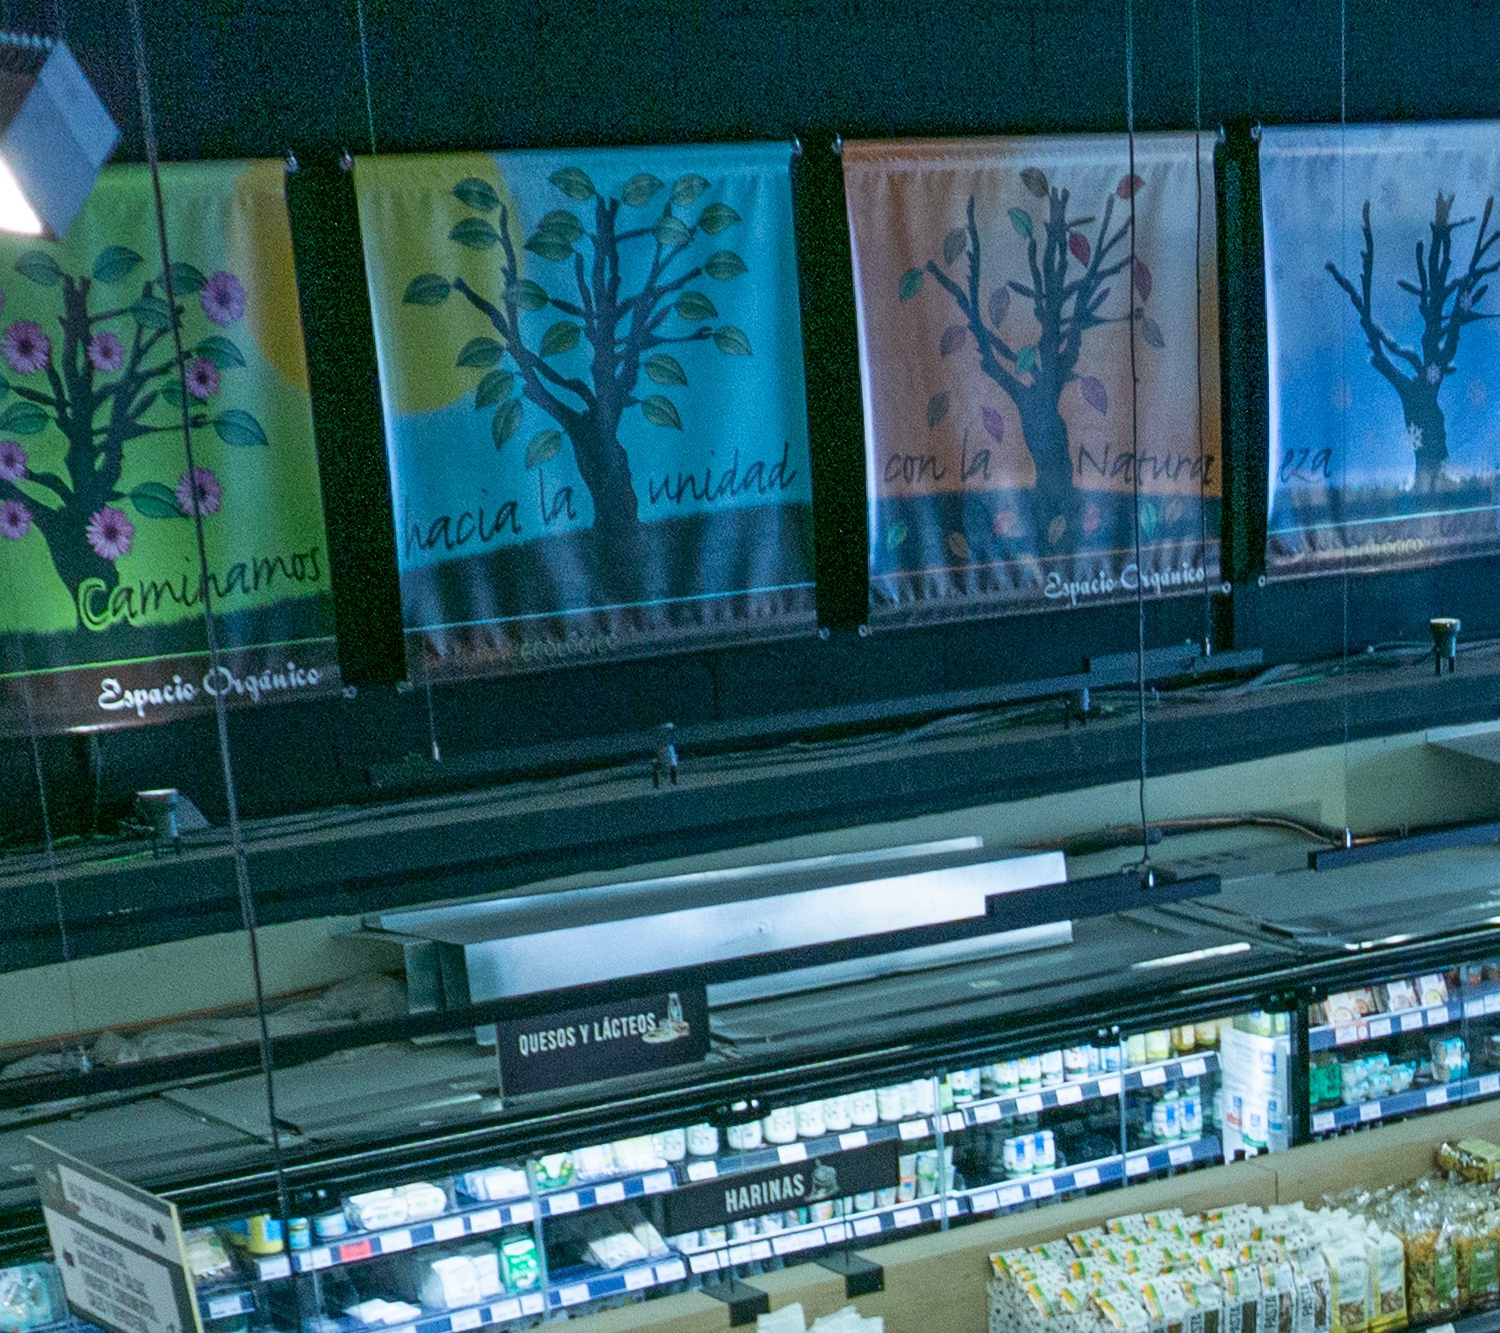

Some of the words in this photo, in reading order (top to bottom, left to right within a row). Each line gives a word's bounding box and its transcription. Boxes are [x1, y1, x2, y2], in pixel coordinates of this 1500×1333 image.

[883, 449, 947, 484] con
[960, 432, 991, 482] la
[404, 488, 522, 560] hacia
[539, 468, 579, 527] la
[649, 441, 798, 505] unidad
[84, 546, 322, 626] Caminamos
[1043, 569, 1115, 606] Espacio
[98, 674, 198, 718] Espacio
[202, 661, 324, 703] Orgánico
[518, 1026, 576, 1057] QUESOS
[579, 1025, 589, 1044] Y
[594, 1012, 657, 1041] LÁCTEOS
[725, 1174, 805, 1213] HARINAS
